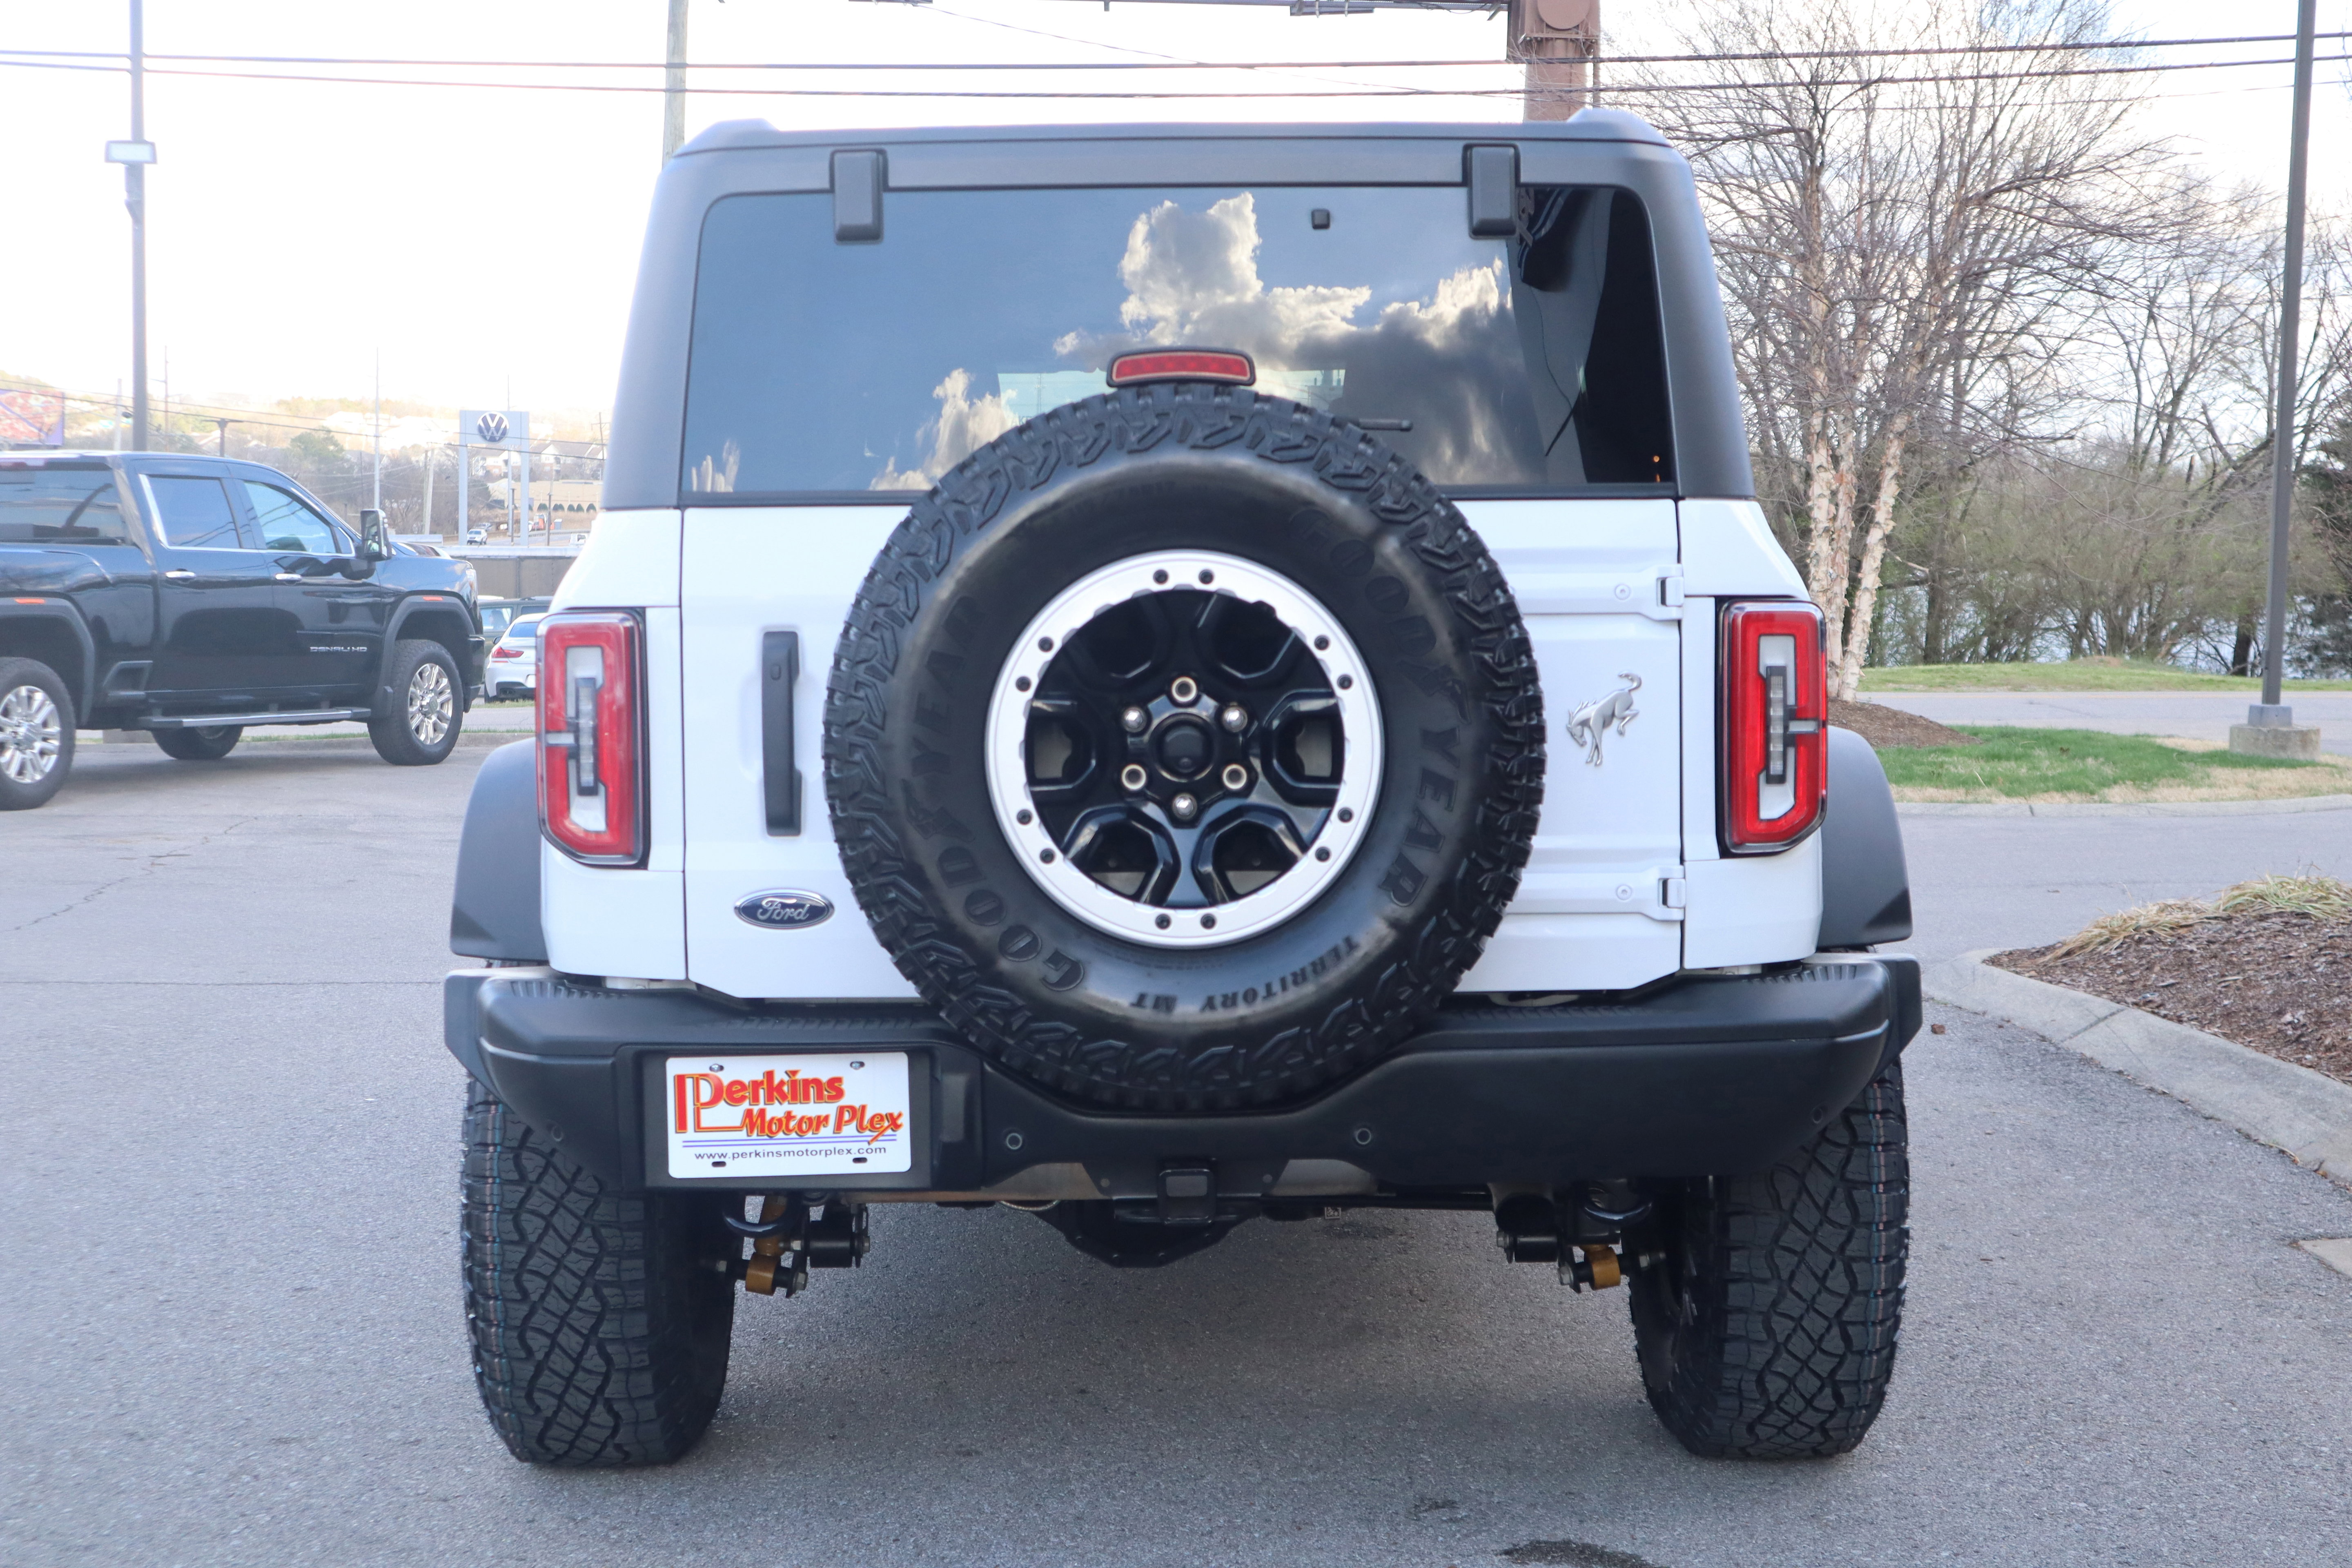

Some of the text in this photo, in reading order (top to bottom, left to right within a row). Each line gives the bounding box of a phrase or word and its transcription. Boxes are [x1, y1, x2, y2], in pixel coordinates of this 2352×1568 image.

[1288, 508, 1461, 907] GOODYEAR
[911, 594, 1085, 991] GOODYEAR
[757, 897, 811, 920] Ford
[1200, 935, 1360, 1012] TERRITORY
[1130, 992, 1178, 1014] MT
[674, 1069, 846, 1132] Perkins
[745, 1103, 904, 1145] Motor Plex
[695, 1145, 886, 1160] www.perkinsmotorplex.com
